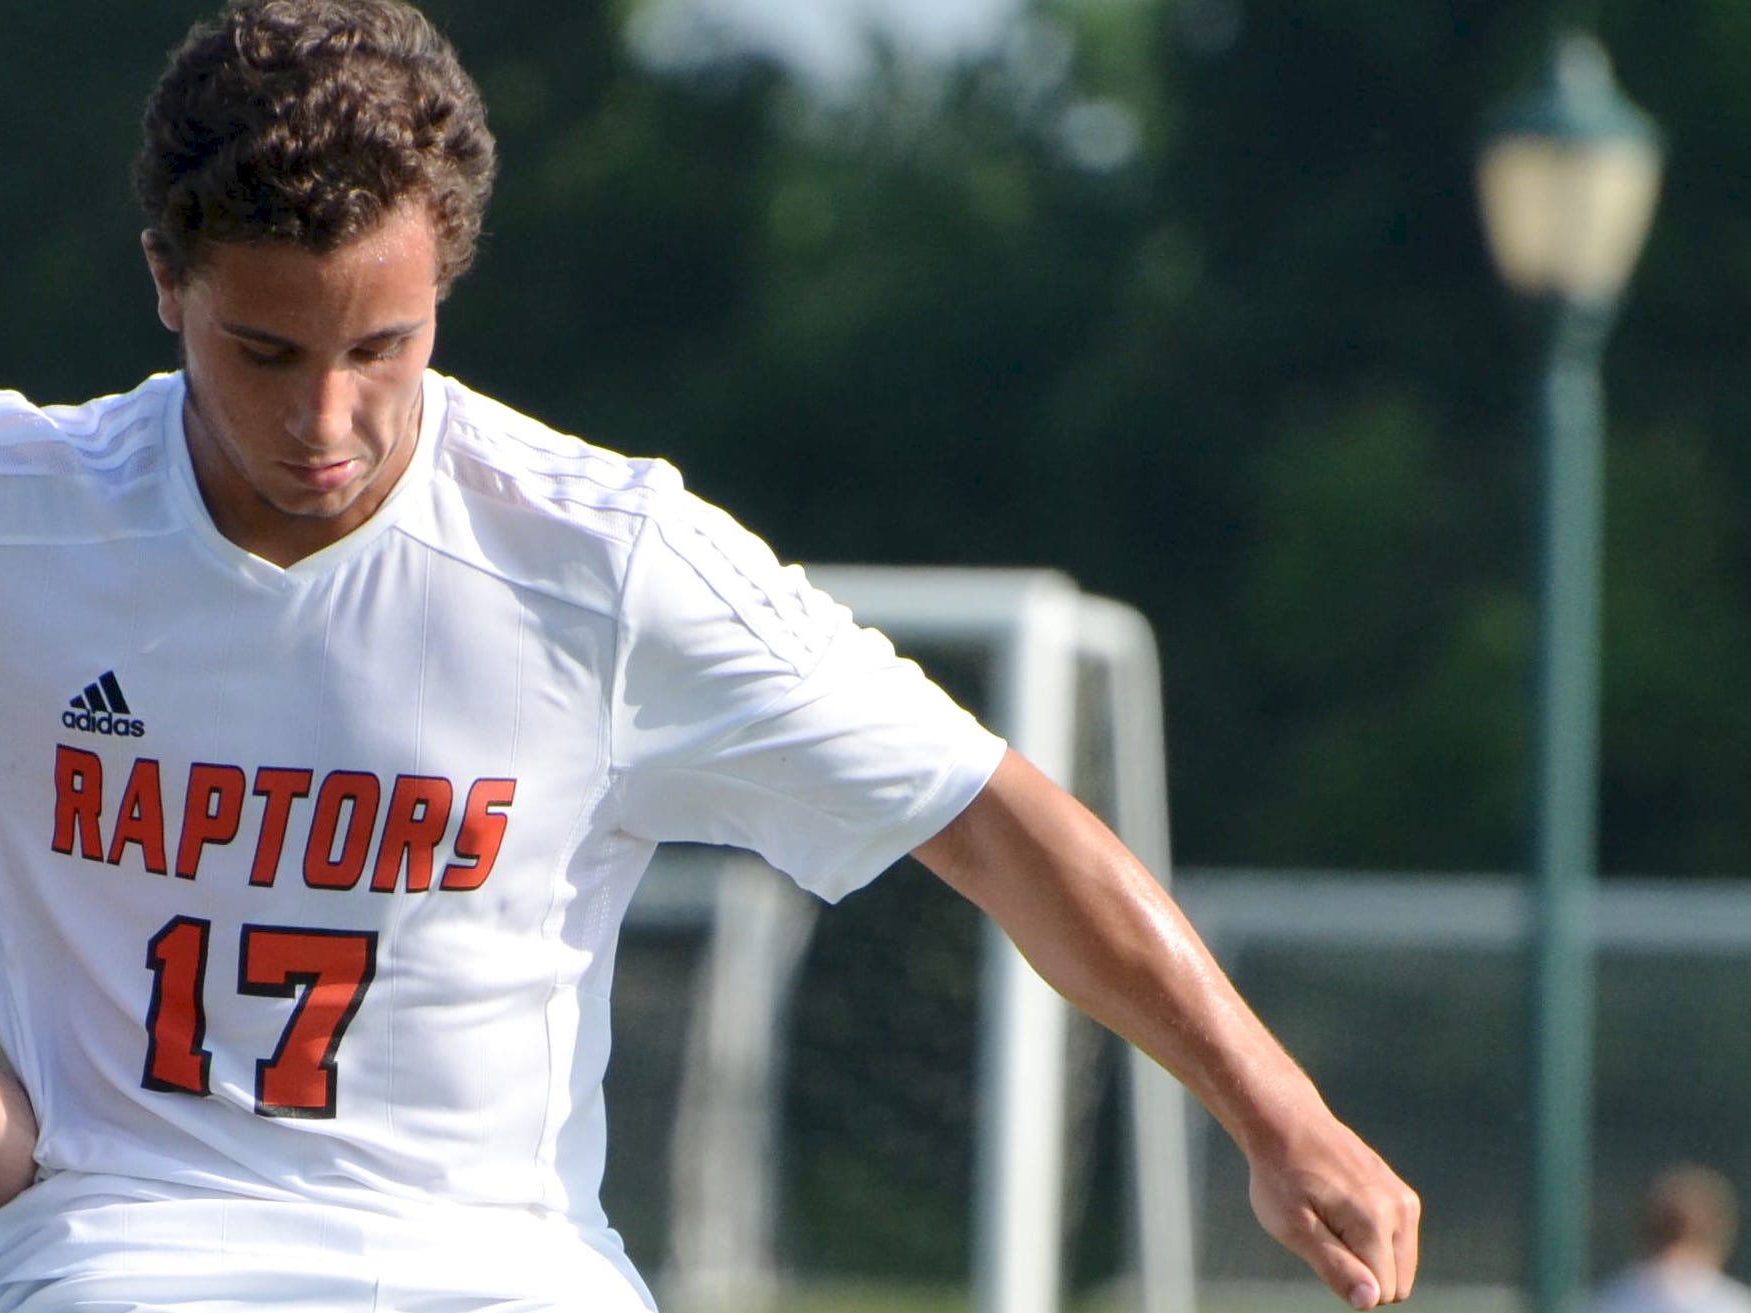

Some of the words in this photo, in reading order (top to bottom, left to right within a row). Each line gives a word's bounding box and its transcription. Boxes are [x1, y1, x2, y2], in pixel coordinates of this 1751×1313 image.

[62, 709, 145, 737] adidas
[51, 743, 517, 893] RAPTORS
[141, 915, 379, 1119] 17
